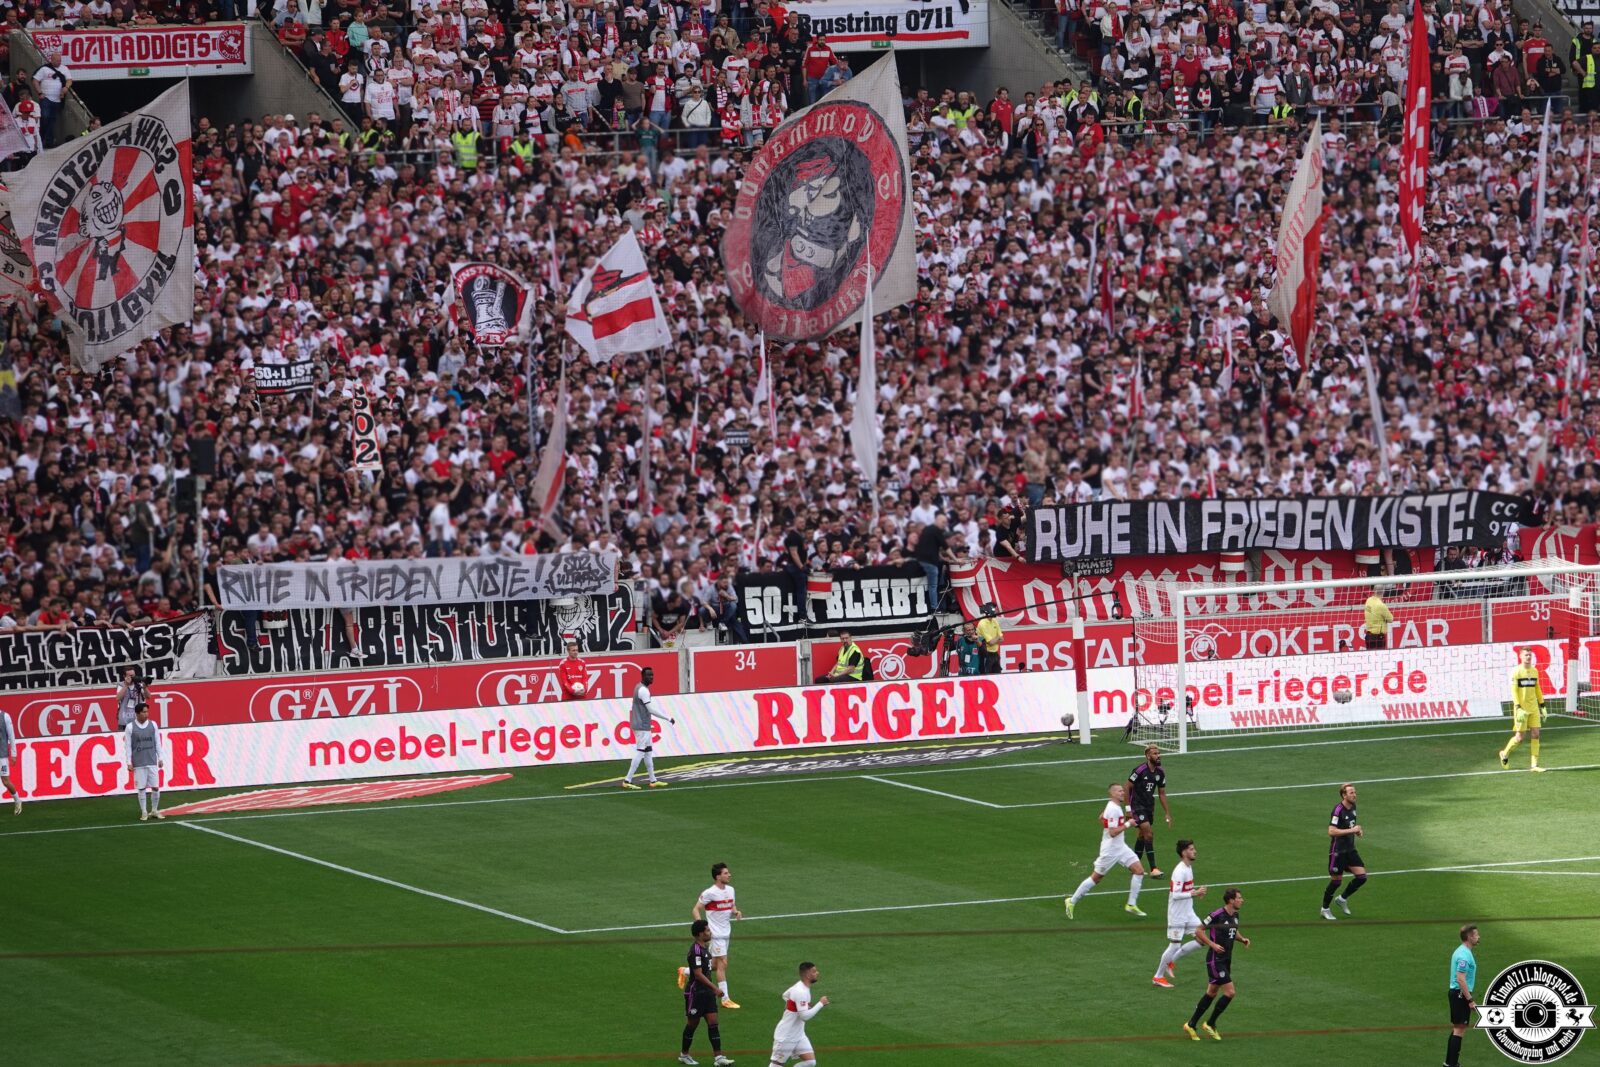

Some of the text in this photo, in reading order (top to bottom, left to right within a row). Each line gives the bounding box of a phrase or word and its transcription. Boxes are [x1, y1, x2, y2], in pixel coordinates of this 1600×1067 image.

[799, 7, 953, 35] Brustring 0711
[70, 36, 114, 62] 0711
[121, 32, 211, 60] ADDICTS
[291, 362, 314, 378] IST
[1034, 490, 1480, 561] RUHE IN FRIEDEN KISTE!
[219, 556, 546, 605] RUHE IN FRIEDEN KISTE!
[826, 575, 929, 620] BLEIBT
[1530, 601, 1551, 622] 35
[734, 651, 757, 671] 34
[753, 678, 1006, 748] RIEGER
[1229, 705, 1321, 728] WINAMAX
[1381, 699, 1472, 721] WINAMAX
[2, 730, 216, 800] IEGR
